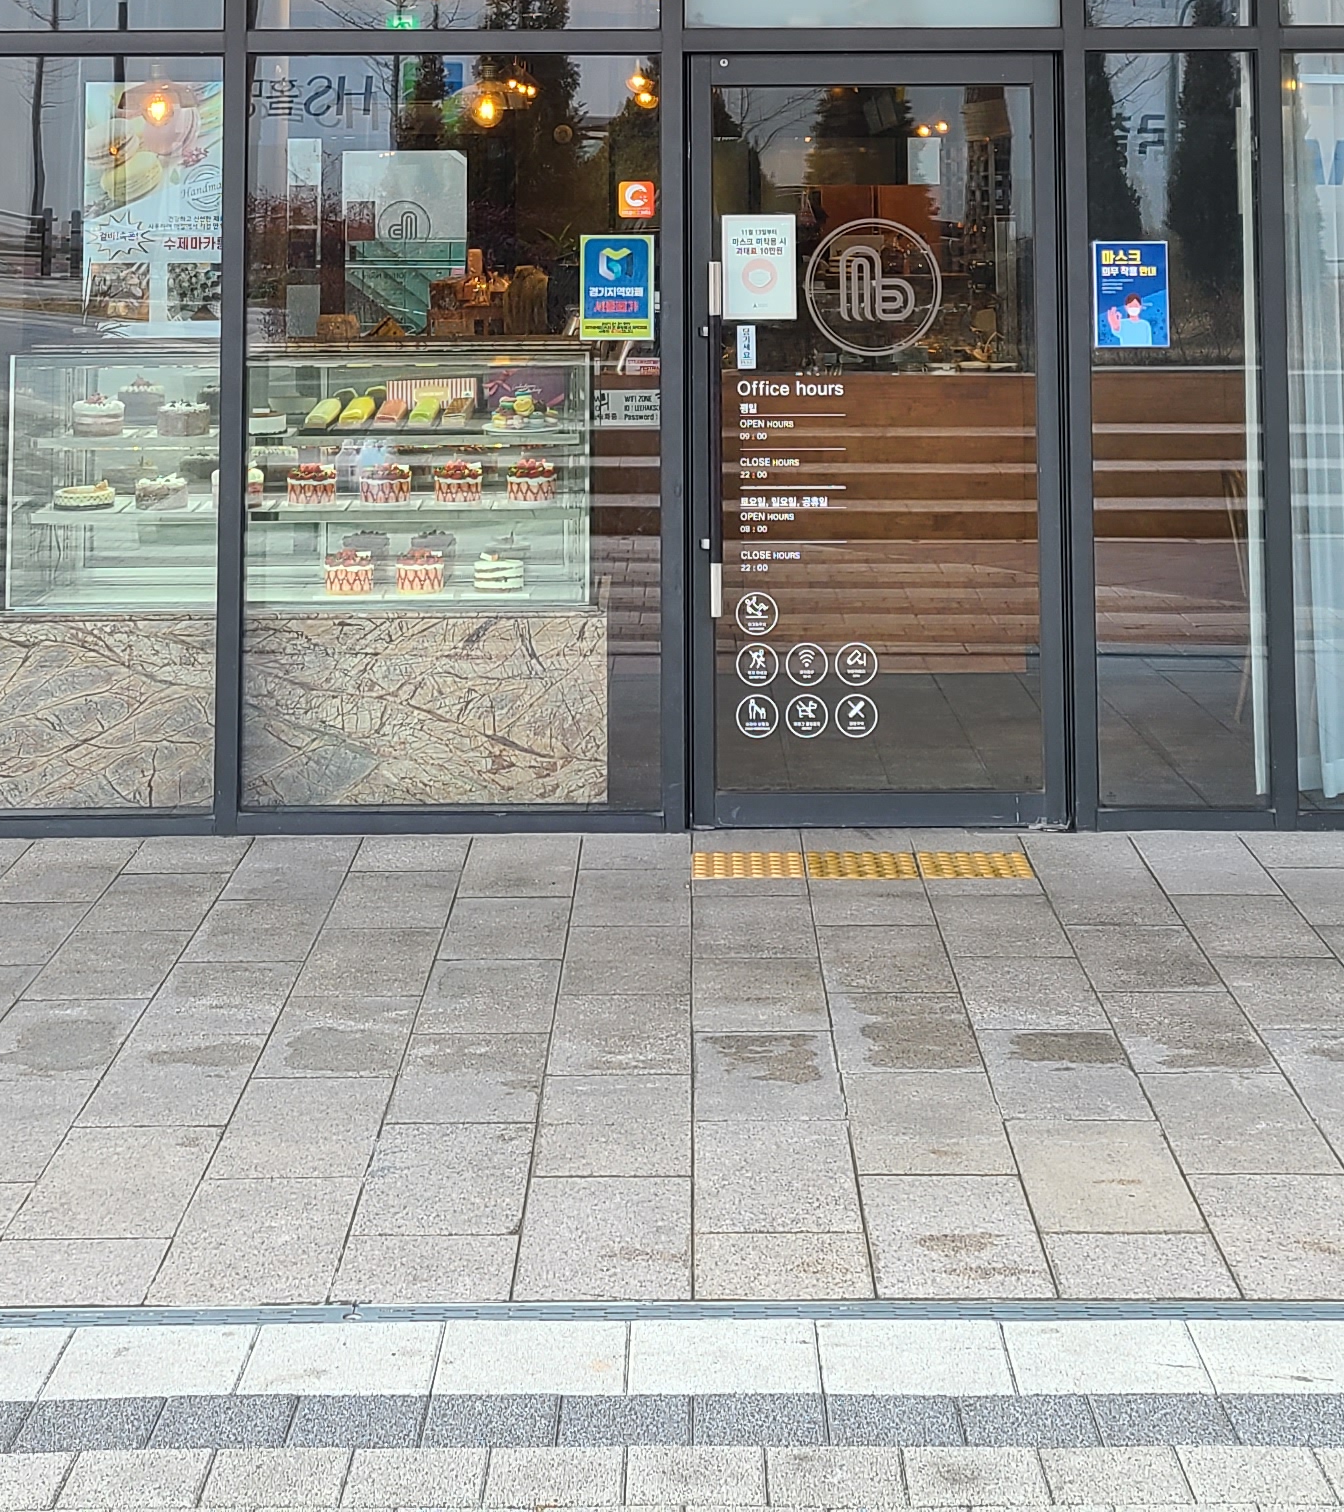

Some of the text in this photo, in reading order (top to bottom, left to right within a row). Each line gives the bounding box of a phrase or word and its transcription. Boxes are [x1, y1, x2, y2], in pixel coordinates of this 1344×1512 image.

[732, 237, 754, 245] 마스크
[1101, 249, 1142, 265] 마스크
[1101, 266, 1119, 277] 의무
[589, 286, 644, 297] 경기지역화폐
[737, 381, 844, 396] Office hours
[739, 419, 794, 428] OPEN HOURS
[739, 458, 771, 466] CLOSE
[740, 512, 795, 521] OPEN HOURS
[740, 551, 801, 560] CLOSE HOURS
